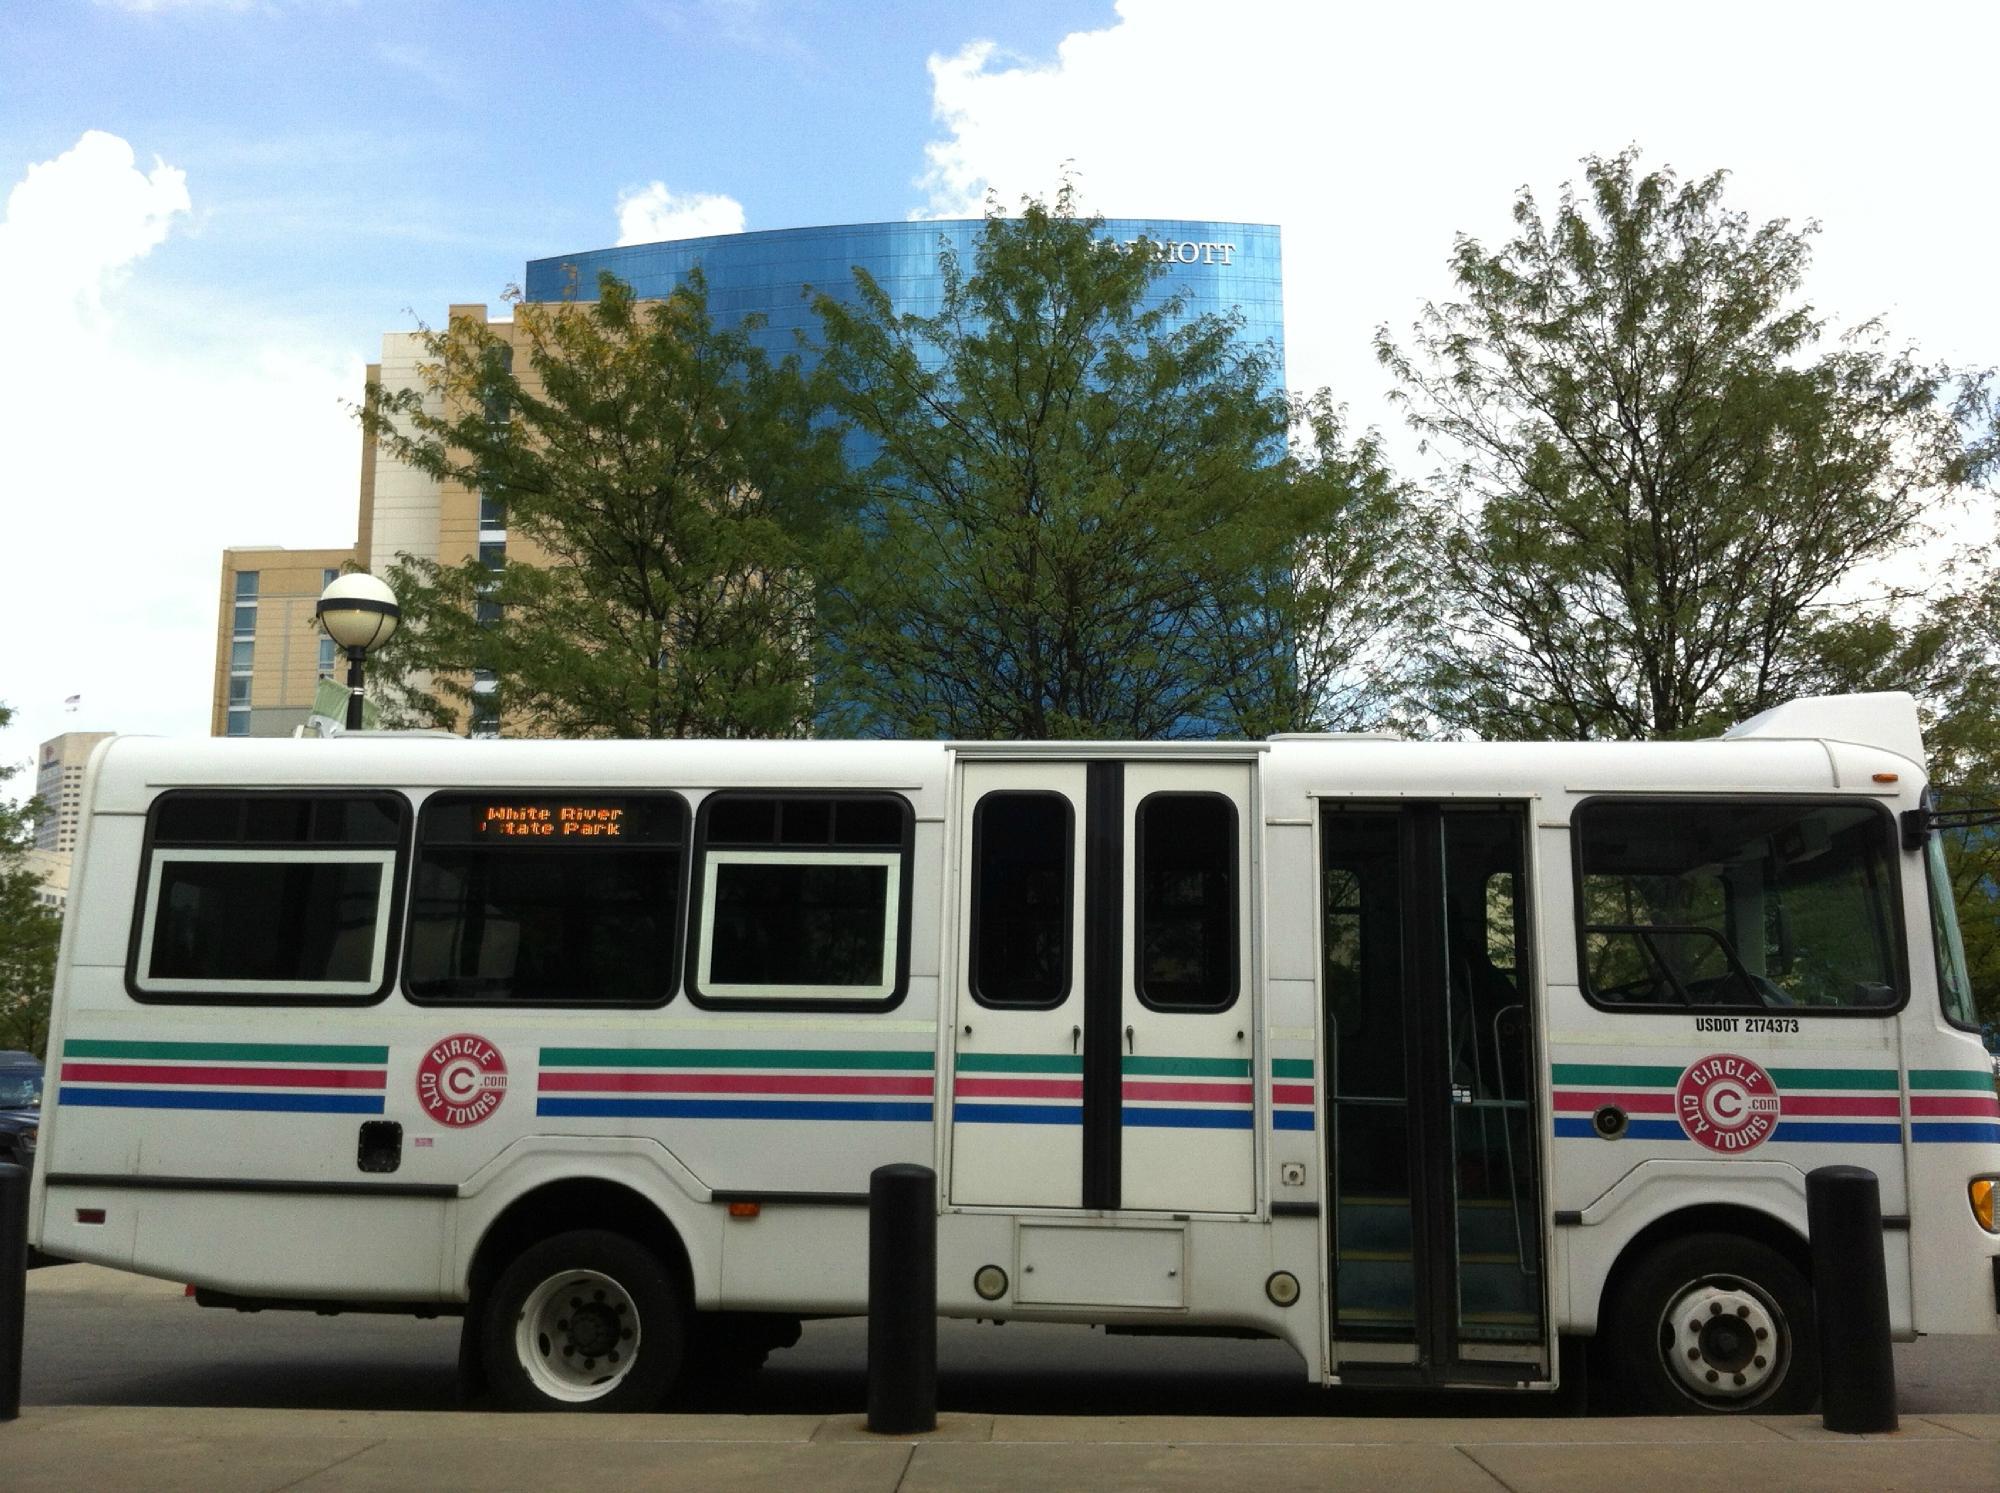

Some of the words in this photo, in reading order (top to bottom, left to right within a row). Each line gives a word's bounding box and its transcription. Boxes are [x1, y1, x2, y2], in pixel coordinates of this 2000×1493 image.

[487, 807, 551, 821] White
[560, 807, 624, 821] River
[495, 822, 554, 836] tate
[563, 822, 621, 836] Park
[1696, 1018, 1739, 1032] USDOT
[1745, 1018, 1799, 1033] 2174373
[432, 1038, 496, 1065] CIRCLE
[1691, 1059, 1762, 1087] CIRCLE
[480, 1075, 508, 1087] .com
[421, 1072, 443, 1111] CITY
[446, 1092, 497, 1124] TOURS
[1748, 1098, 1779, 1111] .com
[1682, 1095, 1710, 1134] CITY
[1714, 1115, 1768, 1149] TOURS
